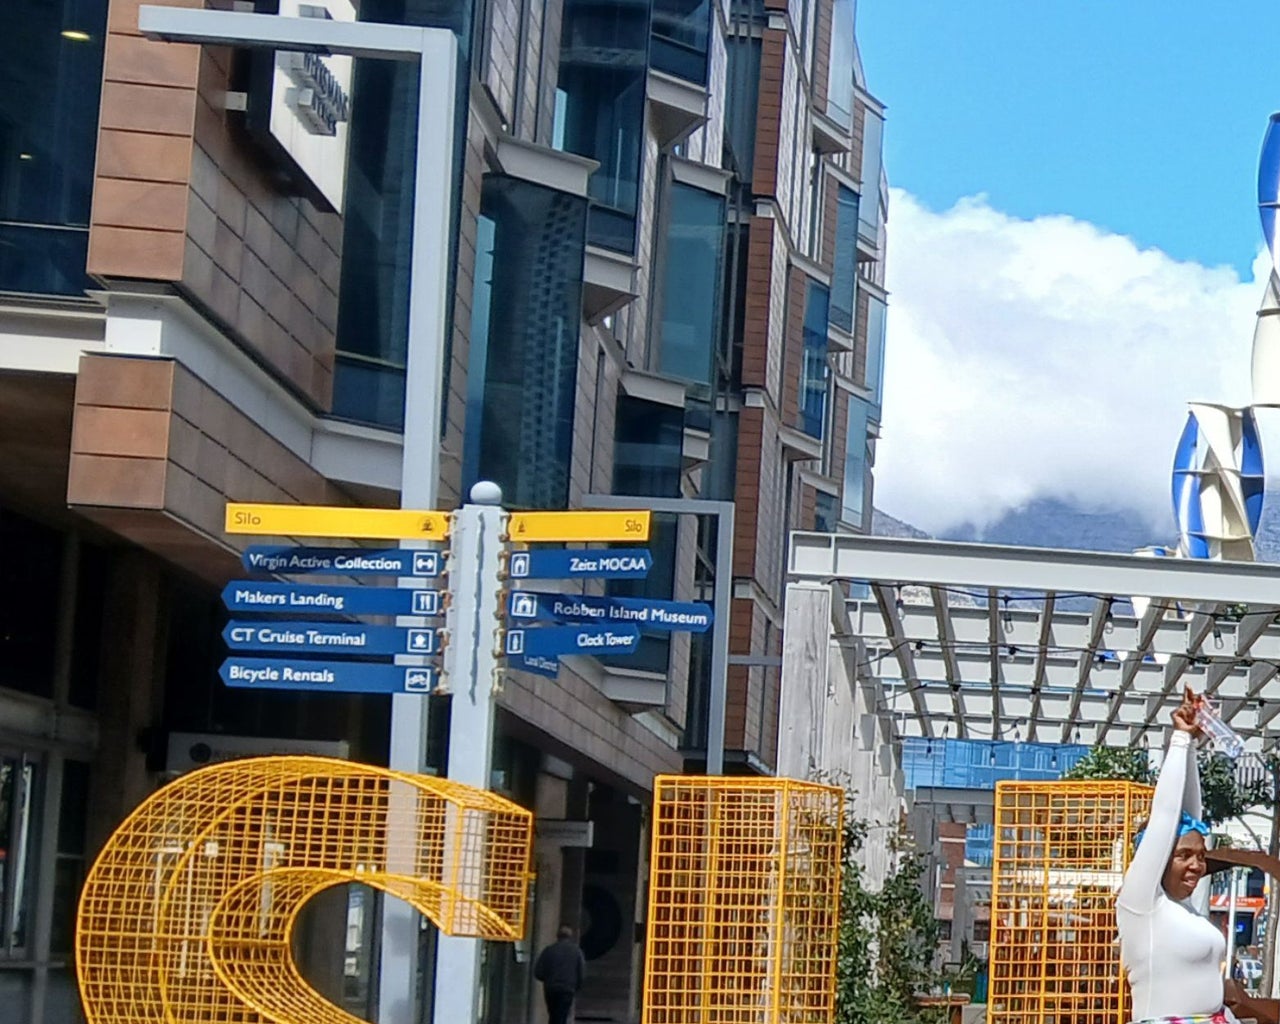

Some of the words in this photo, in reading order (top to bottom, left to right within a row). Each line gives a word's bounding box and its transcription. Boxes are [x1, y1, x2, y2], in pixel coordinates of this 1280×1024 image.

[235, 512, 261, 526] Silo
[625, 520, 642, 532] Silo
[250, 554, 286, 570] Virgin
[289, 556, 331, 569] Active
[334, 556, 402, 570] Collection
[600, 558, 647, 571] MOCAA
[235, 590, 286, 605] Makers
[290, 592, 344, 610] Landing
[554, 601, 605, 618] Robben
[609, 605, 648, 620] Island
[651, 607, 707, 625] Museum
[230, 628, 255, 642] CT
[258, 628, 304, 644] Cruise
[306, 630, 366, 646] Terminal
[577, 633, 604, 647] Clock
[604, 632, 634, 645] Tower
[229, 666, 279, 683] Bicycle
[283, 667, 335, 683] Rentals
